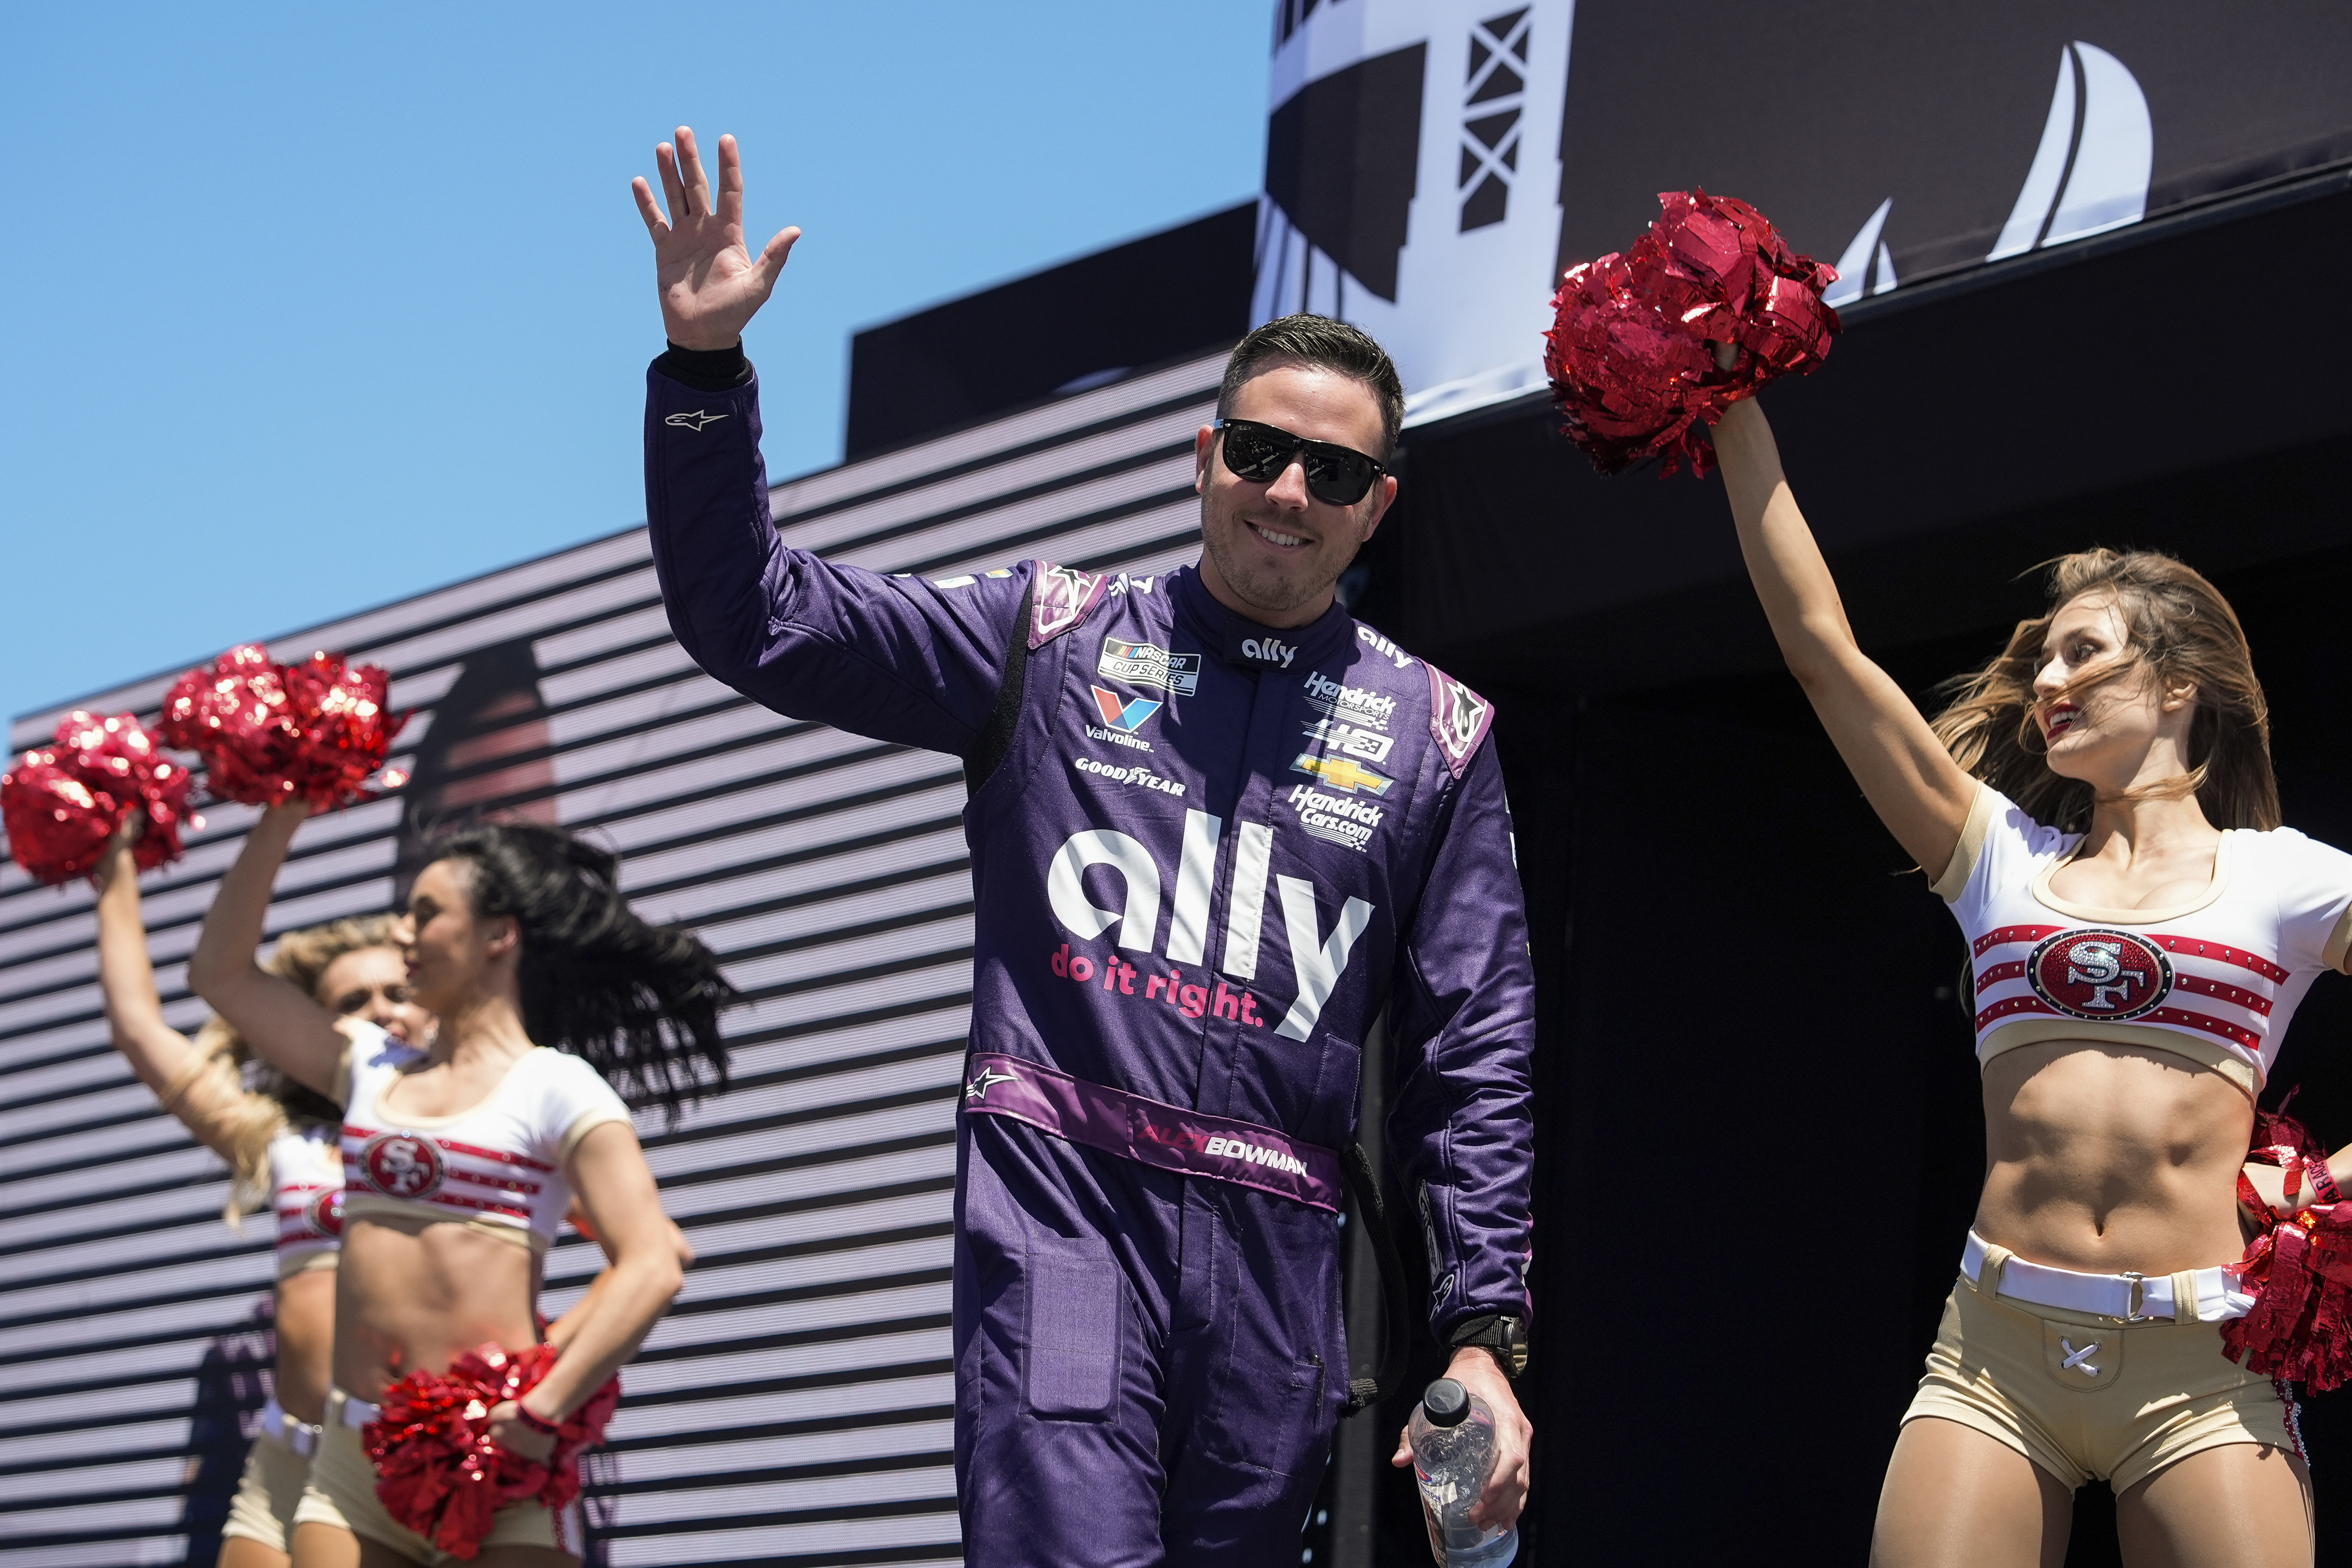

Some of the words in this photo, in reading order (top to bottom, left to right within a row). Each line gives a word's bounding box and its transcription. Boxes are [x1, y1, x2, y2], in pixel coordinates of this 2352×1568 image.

[1134, 646, 1186, 669] NASCAR
[1242, 637, 1298, 668] ally
[1358, 626, 1413, 669] ally
[1113, 661, 1140, 674] CUP
[1139, 664, 1184, 685] SERIES
[1303, 670, 1397, 715] Hendrick
[1318, 693, 1390, 720] MOTORSPORTS
[1085, 724, 1150, 751] Valvoline
[1075, 757, 1186, 797] GOODYEAR
[1288, 784, 1383, 827] Hendrick
[1300, 808, 1373, 841] Cars.com
[1047, 808, 1375, 1043] ally
[1051, 944, 1094, 981] do
[1104, 955, 1136, 995] it
[1145, 969, 1264, 1028] right.
[2067, 939, 2146, 1010] SF
[1137, 1124, 1211, 1153] ALEX
[1204, 1136, 1307, 1178] BOWMAN
